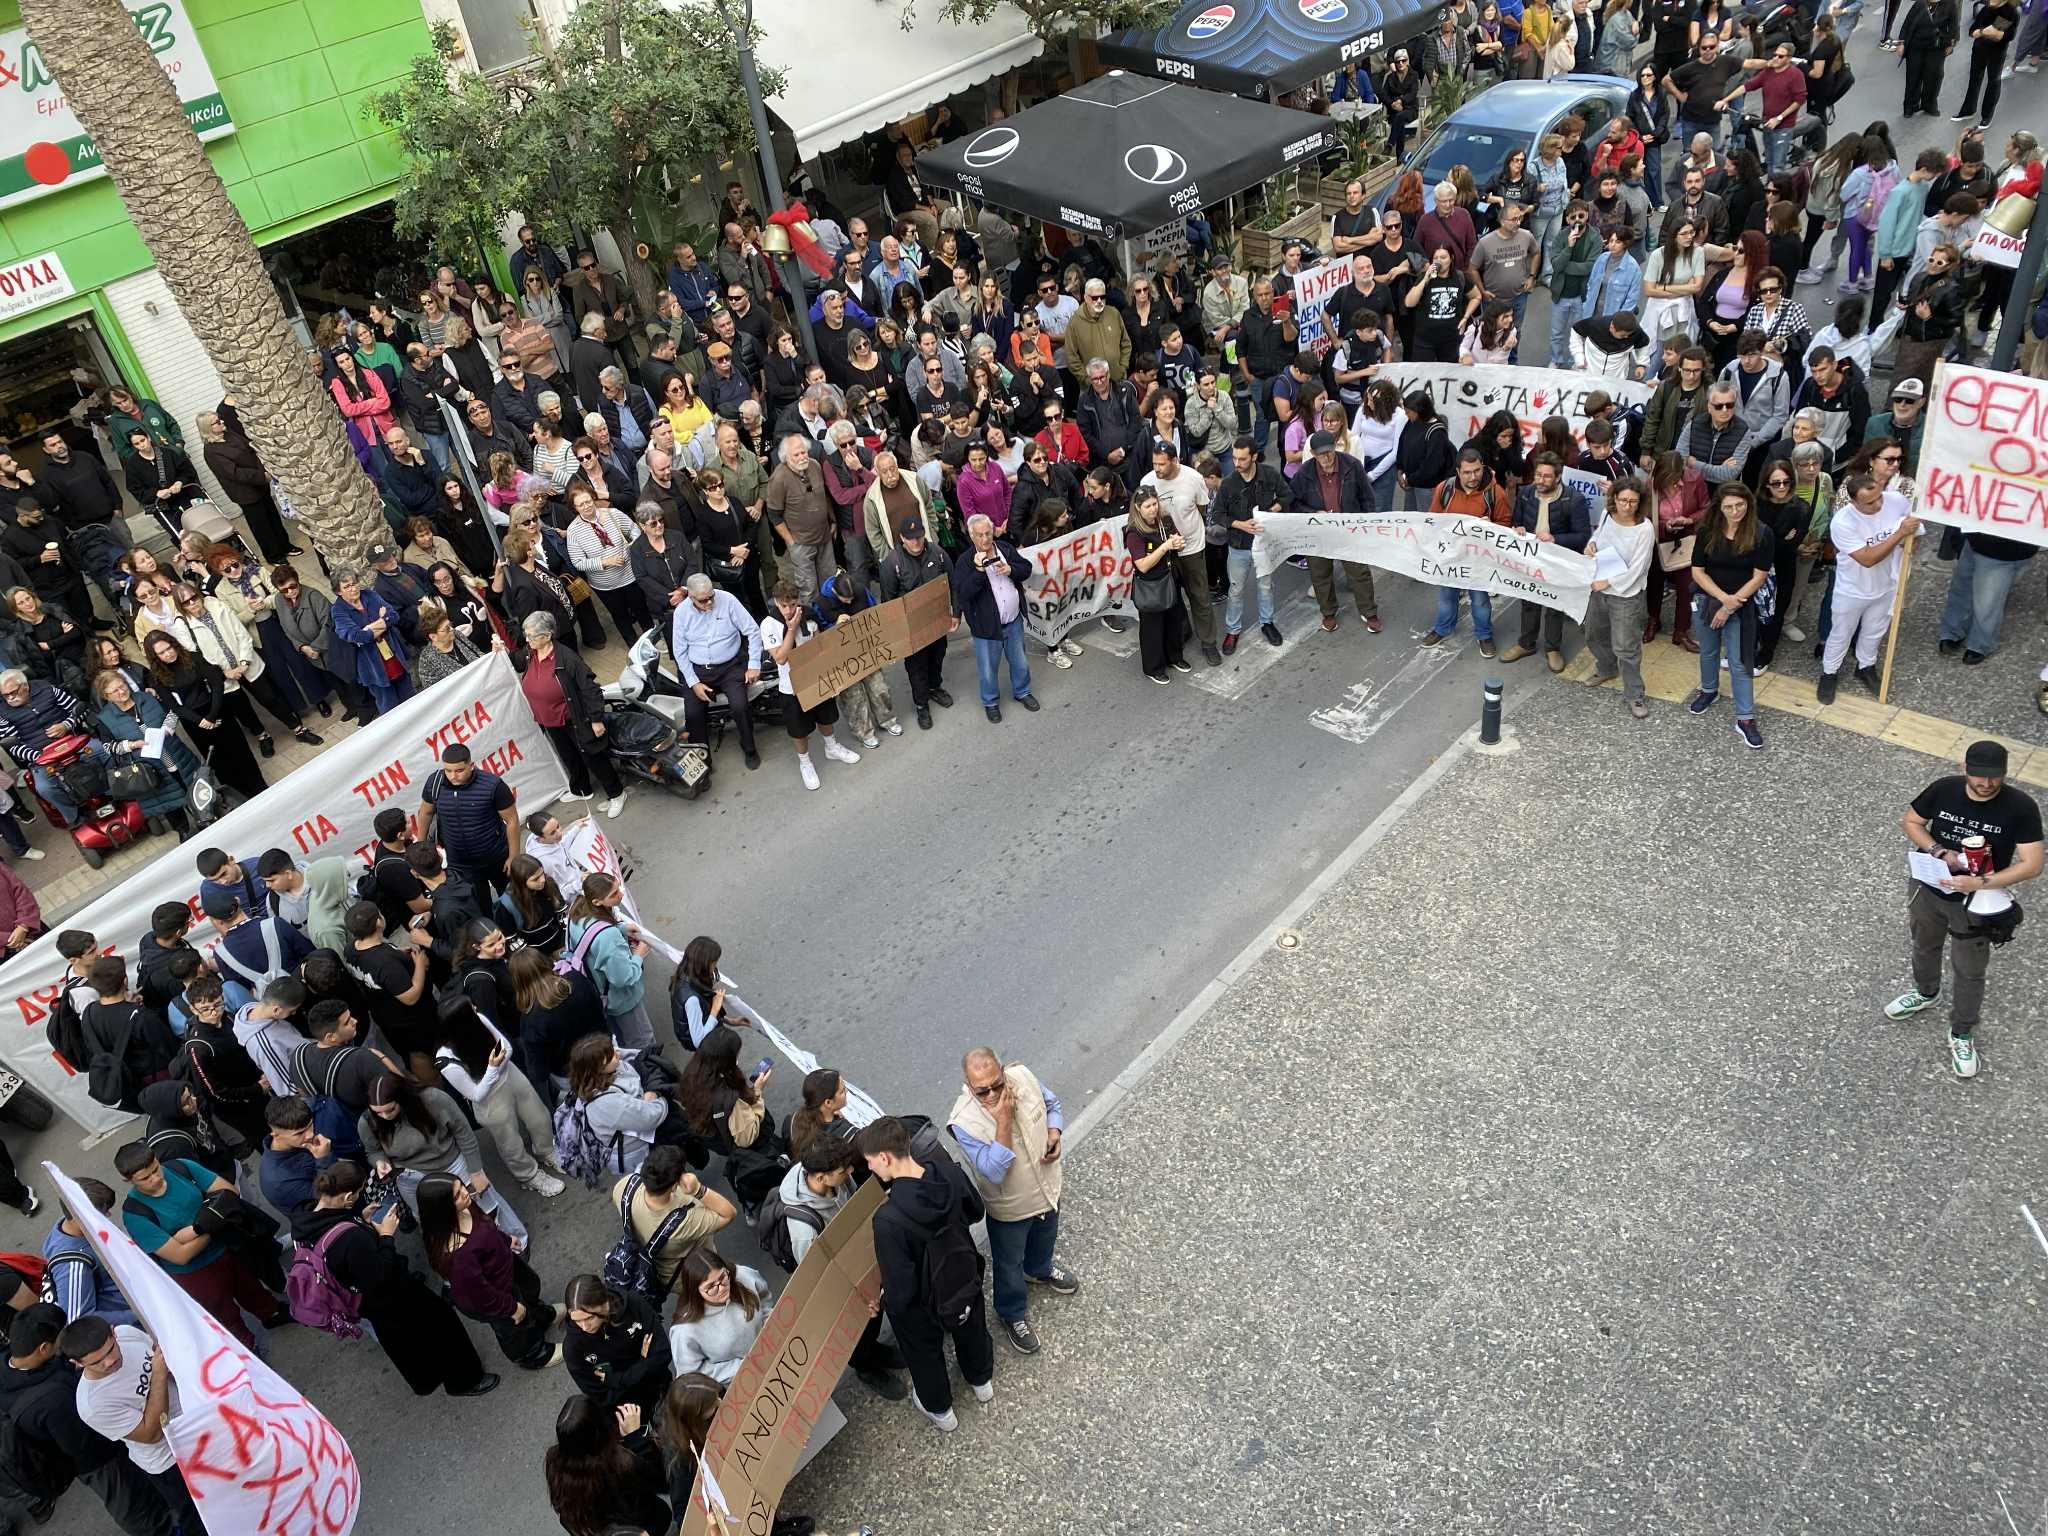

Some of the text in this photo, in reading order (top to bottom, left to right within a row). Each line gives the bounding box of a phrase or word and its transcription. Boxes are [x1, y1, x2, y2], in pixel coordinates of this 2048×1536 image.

[1194, 16, 1226, 28] PEPSI
[1340, 29, 1384, 62] PEPSI
[1156, 57, 1195, 80] PEPSI
[957, 172, 982, 187] pepsi
[964, 183, 984, 197] max
[1169, 182, 1199, 209] pepsi
[1177, 195, 1202, 216] max
[1978, 230, 1997, 247] ΓΙΑ
[1302, 263, 1350, 303] Η ΥΓΕΙΑ
[1503, 384, 1529, 417] ΤΑ
[1037, 529, 1114, 577] ΥΓΕΙΑ
[1421, 558, 1472, 579] ΕΛΜΕ
[836, 608, 882, 648] ΣΤΗΝ
[856, 630, 886, 653] ΤΗΣ
[816, 643, 898, 698] ΔΗΜΟΣΙΑΣ
[291, 700, 493, 855] ΓΙΑ ΤΗΝ ΥΓΕΙΑ
